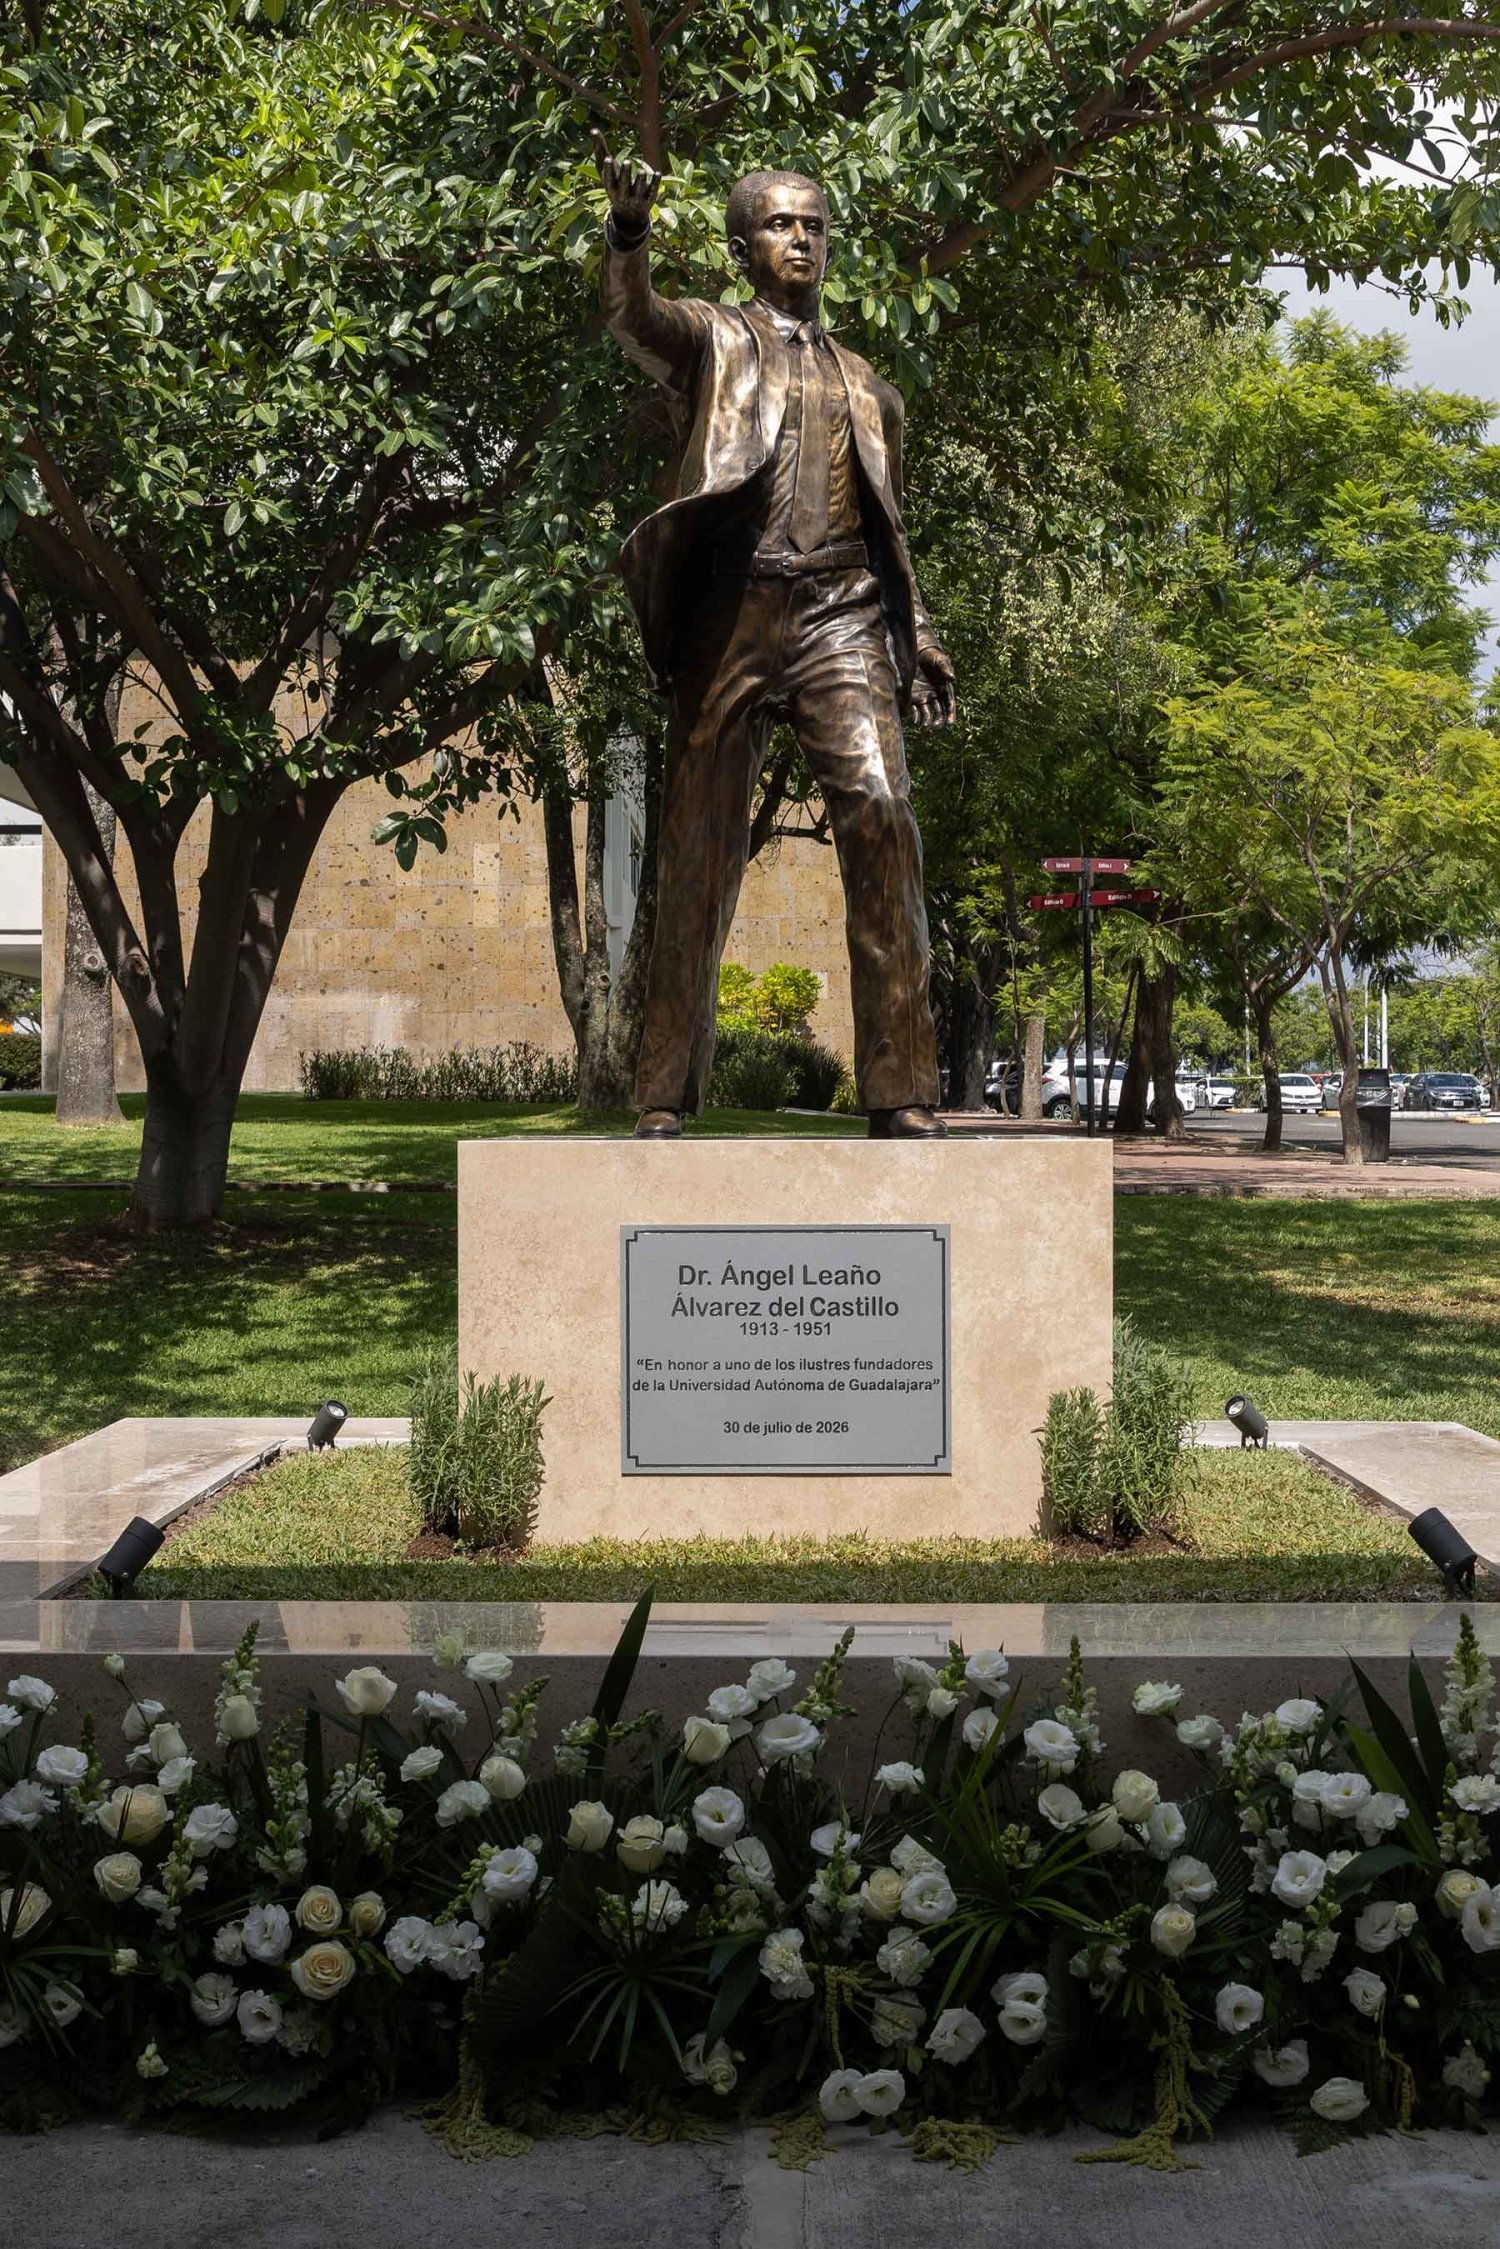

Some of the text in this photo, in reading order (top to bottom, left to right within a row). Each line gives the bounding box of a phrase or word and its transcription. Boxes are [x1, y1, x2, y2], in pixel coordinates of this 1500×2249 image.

[678, 1260, 882, 1291] Dr. Ángel Leaño
[671, 1292, 900, 1317] Álvarez del Castillo
[739, 1321, 779, 1336] 1913
[794, 1321, 831, 1336] 1951
[667, 1359, 710, 1371] honor
[712, 1361, 721, 1371] a
[725, 1361, 751, 1371] uno
[753, 1358, 772, 1371] de
[775, 1358, 796, 1371] los
[799, 1358, 851, 1371] ilustres
[853, 1358, 934, 1371] fundadores
[632, 1379, 650, 1391] de
[653, 1379, 666, 1391] la
[669, 1379, 751, 1391] Universidad
[754, 1378, 825, 1391] Autónoma
[827, 1379, 846, 1391] de
[723, 1421, 850, 1436] 30 de julio de 2026
